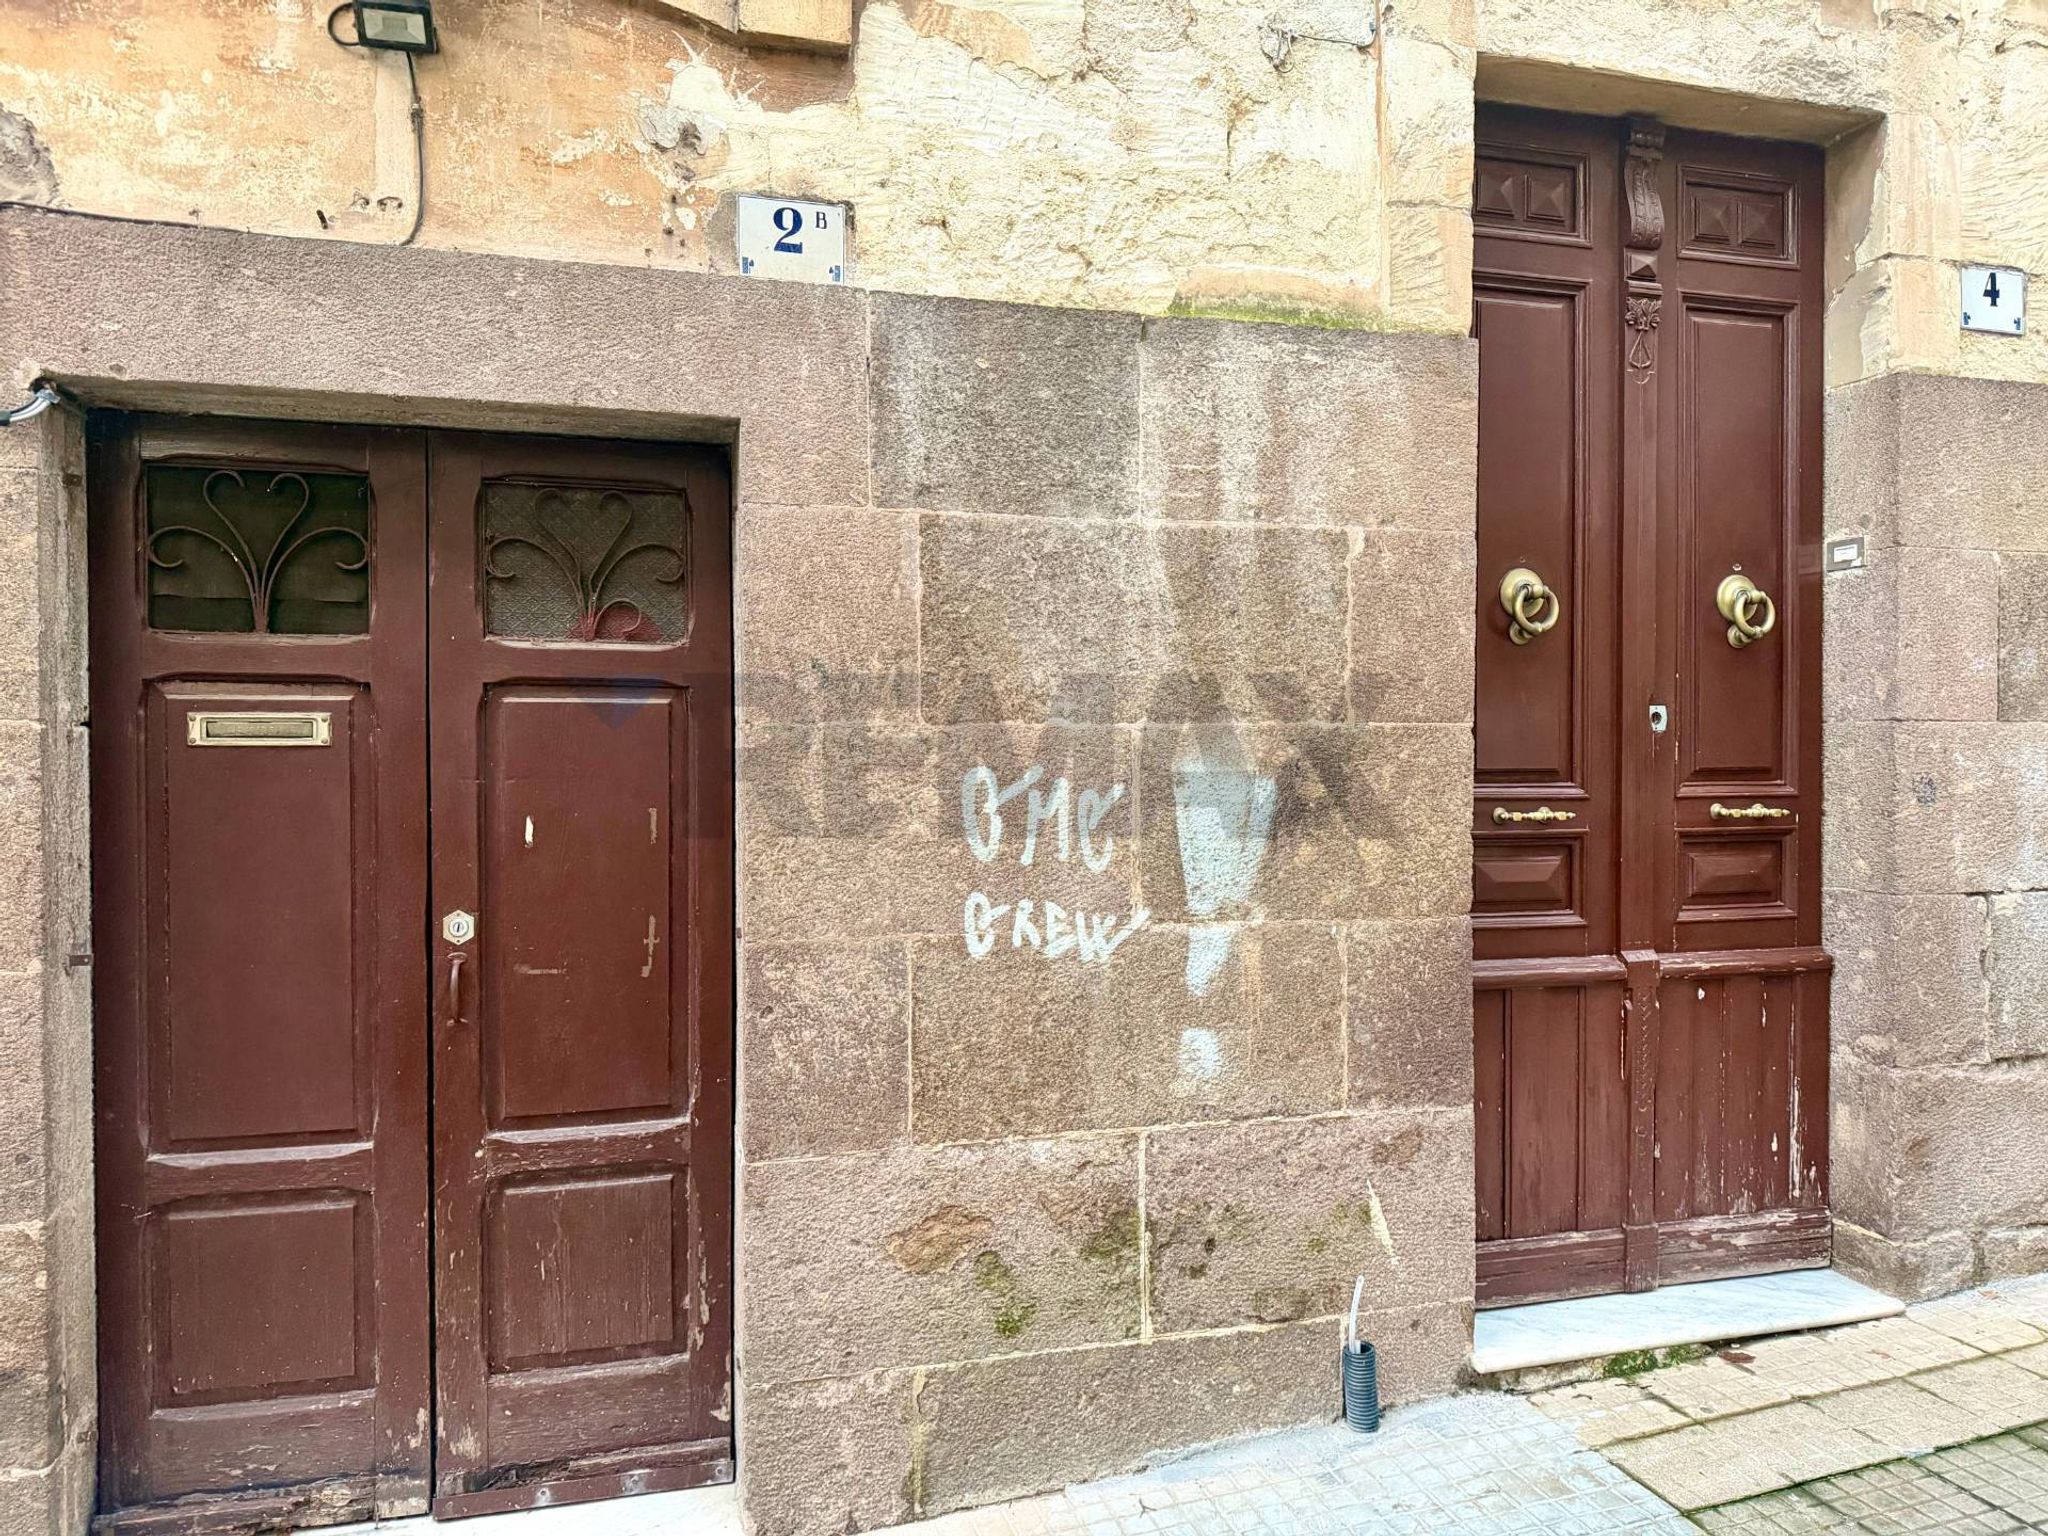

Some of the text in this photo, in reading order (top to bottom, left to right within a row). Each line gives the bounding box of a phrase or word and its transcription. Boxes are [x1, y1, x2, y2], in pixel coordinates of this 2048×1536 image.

[773, 206, 827, 254] 2 B
[1983, 272, 2000, 307] 4
